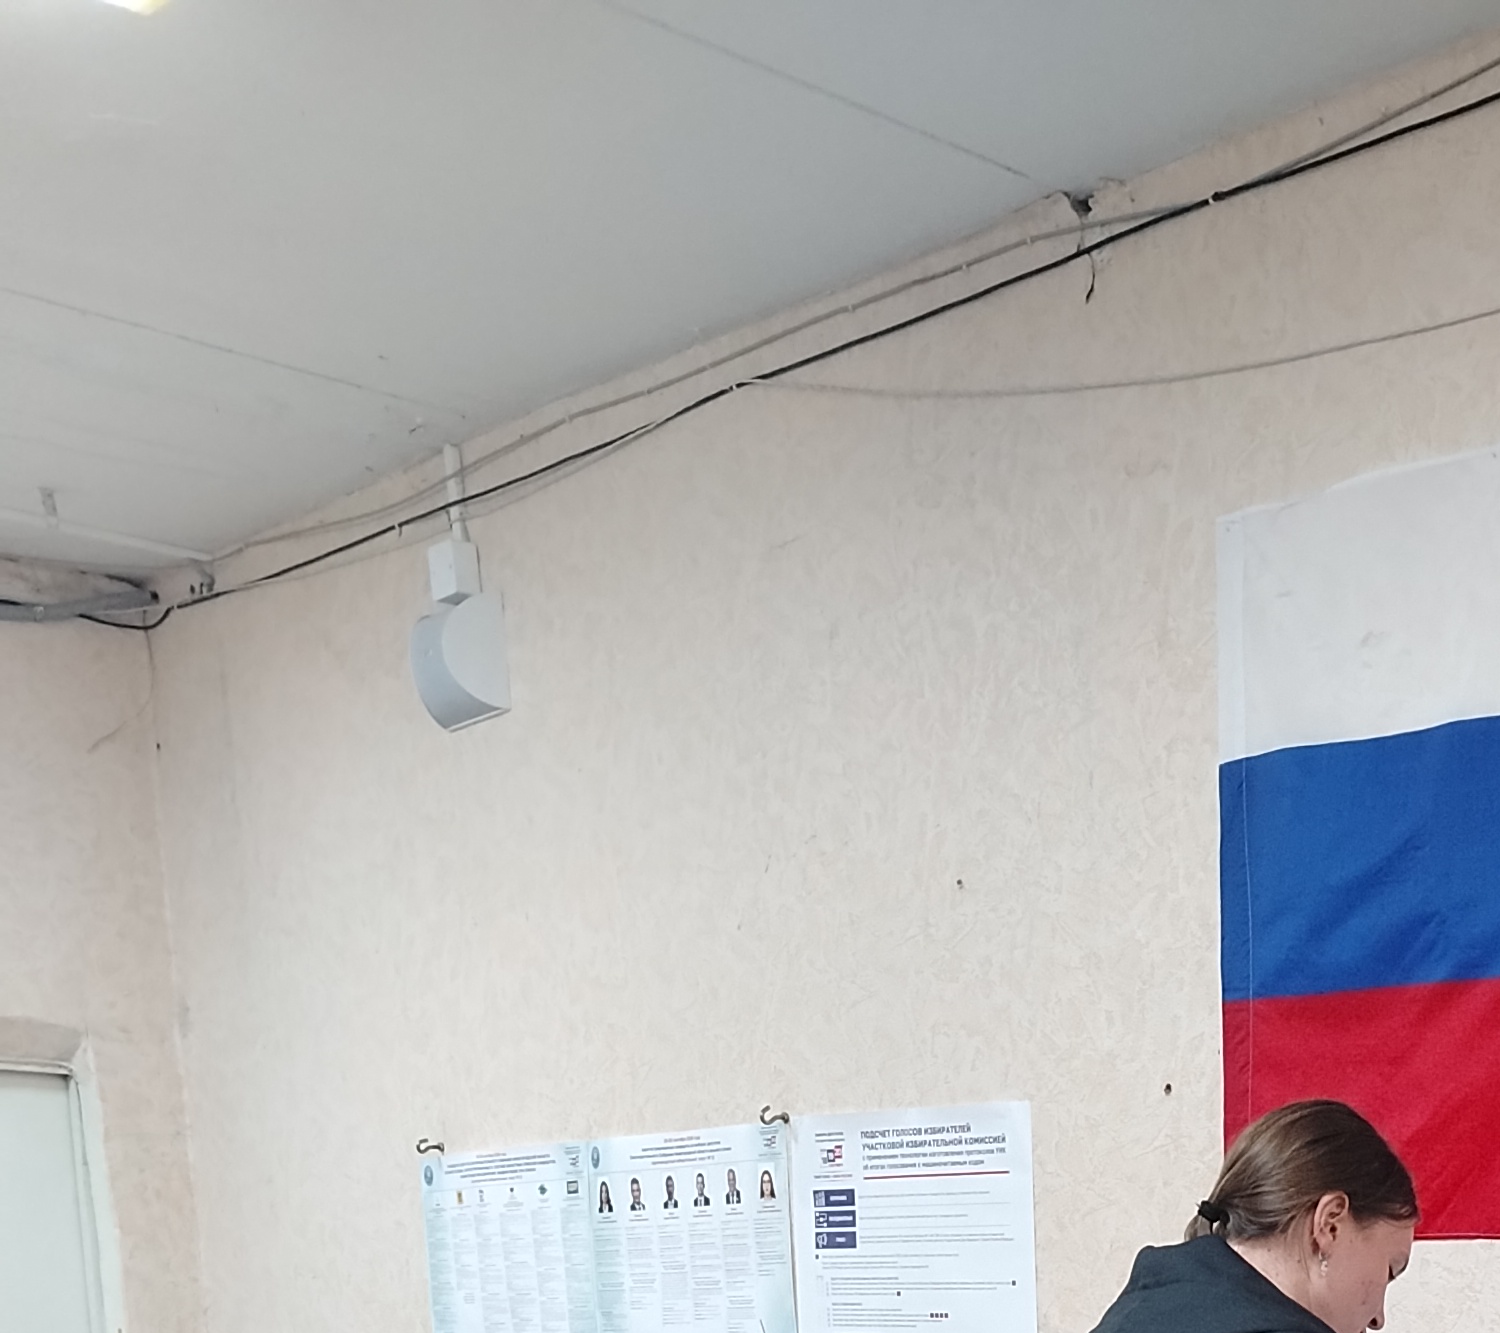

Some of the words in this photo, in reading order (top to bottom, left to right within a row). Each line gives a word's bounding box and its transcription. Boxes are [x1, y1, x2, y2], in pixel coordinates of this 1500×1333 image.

[861, 1129, 890, 1140] ПОДСЧЕТ
[892, 1128, 923, 1138] ГОЛОСОВ
[924, 1122, 972, 1136] ИЗБИРАТЕЛЕЙ
[862, 1140, 904, 1152] УЧАСТКОВОЙ
[906, 1136, 963, 1148] ИЗБИРАТЕЛЬНОЙ
[964, 1134, 1006, 1146] КОМИССИЕЙ
